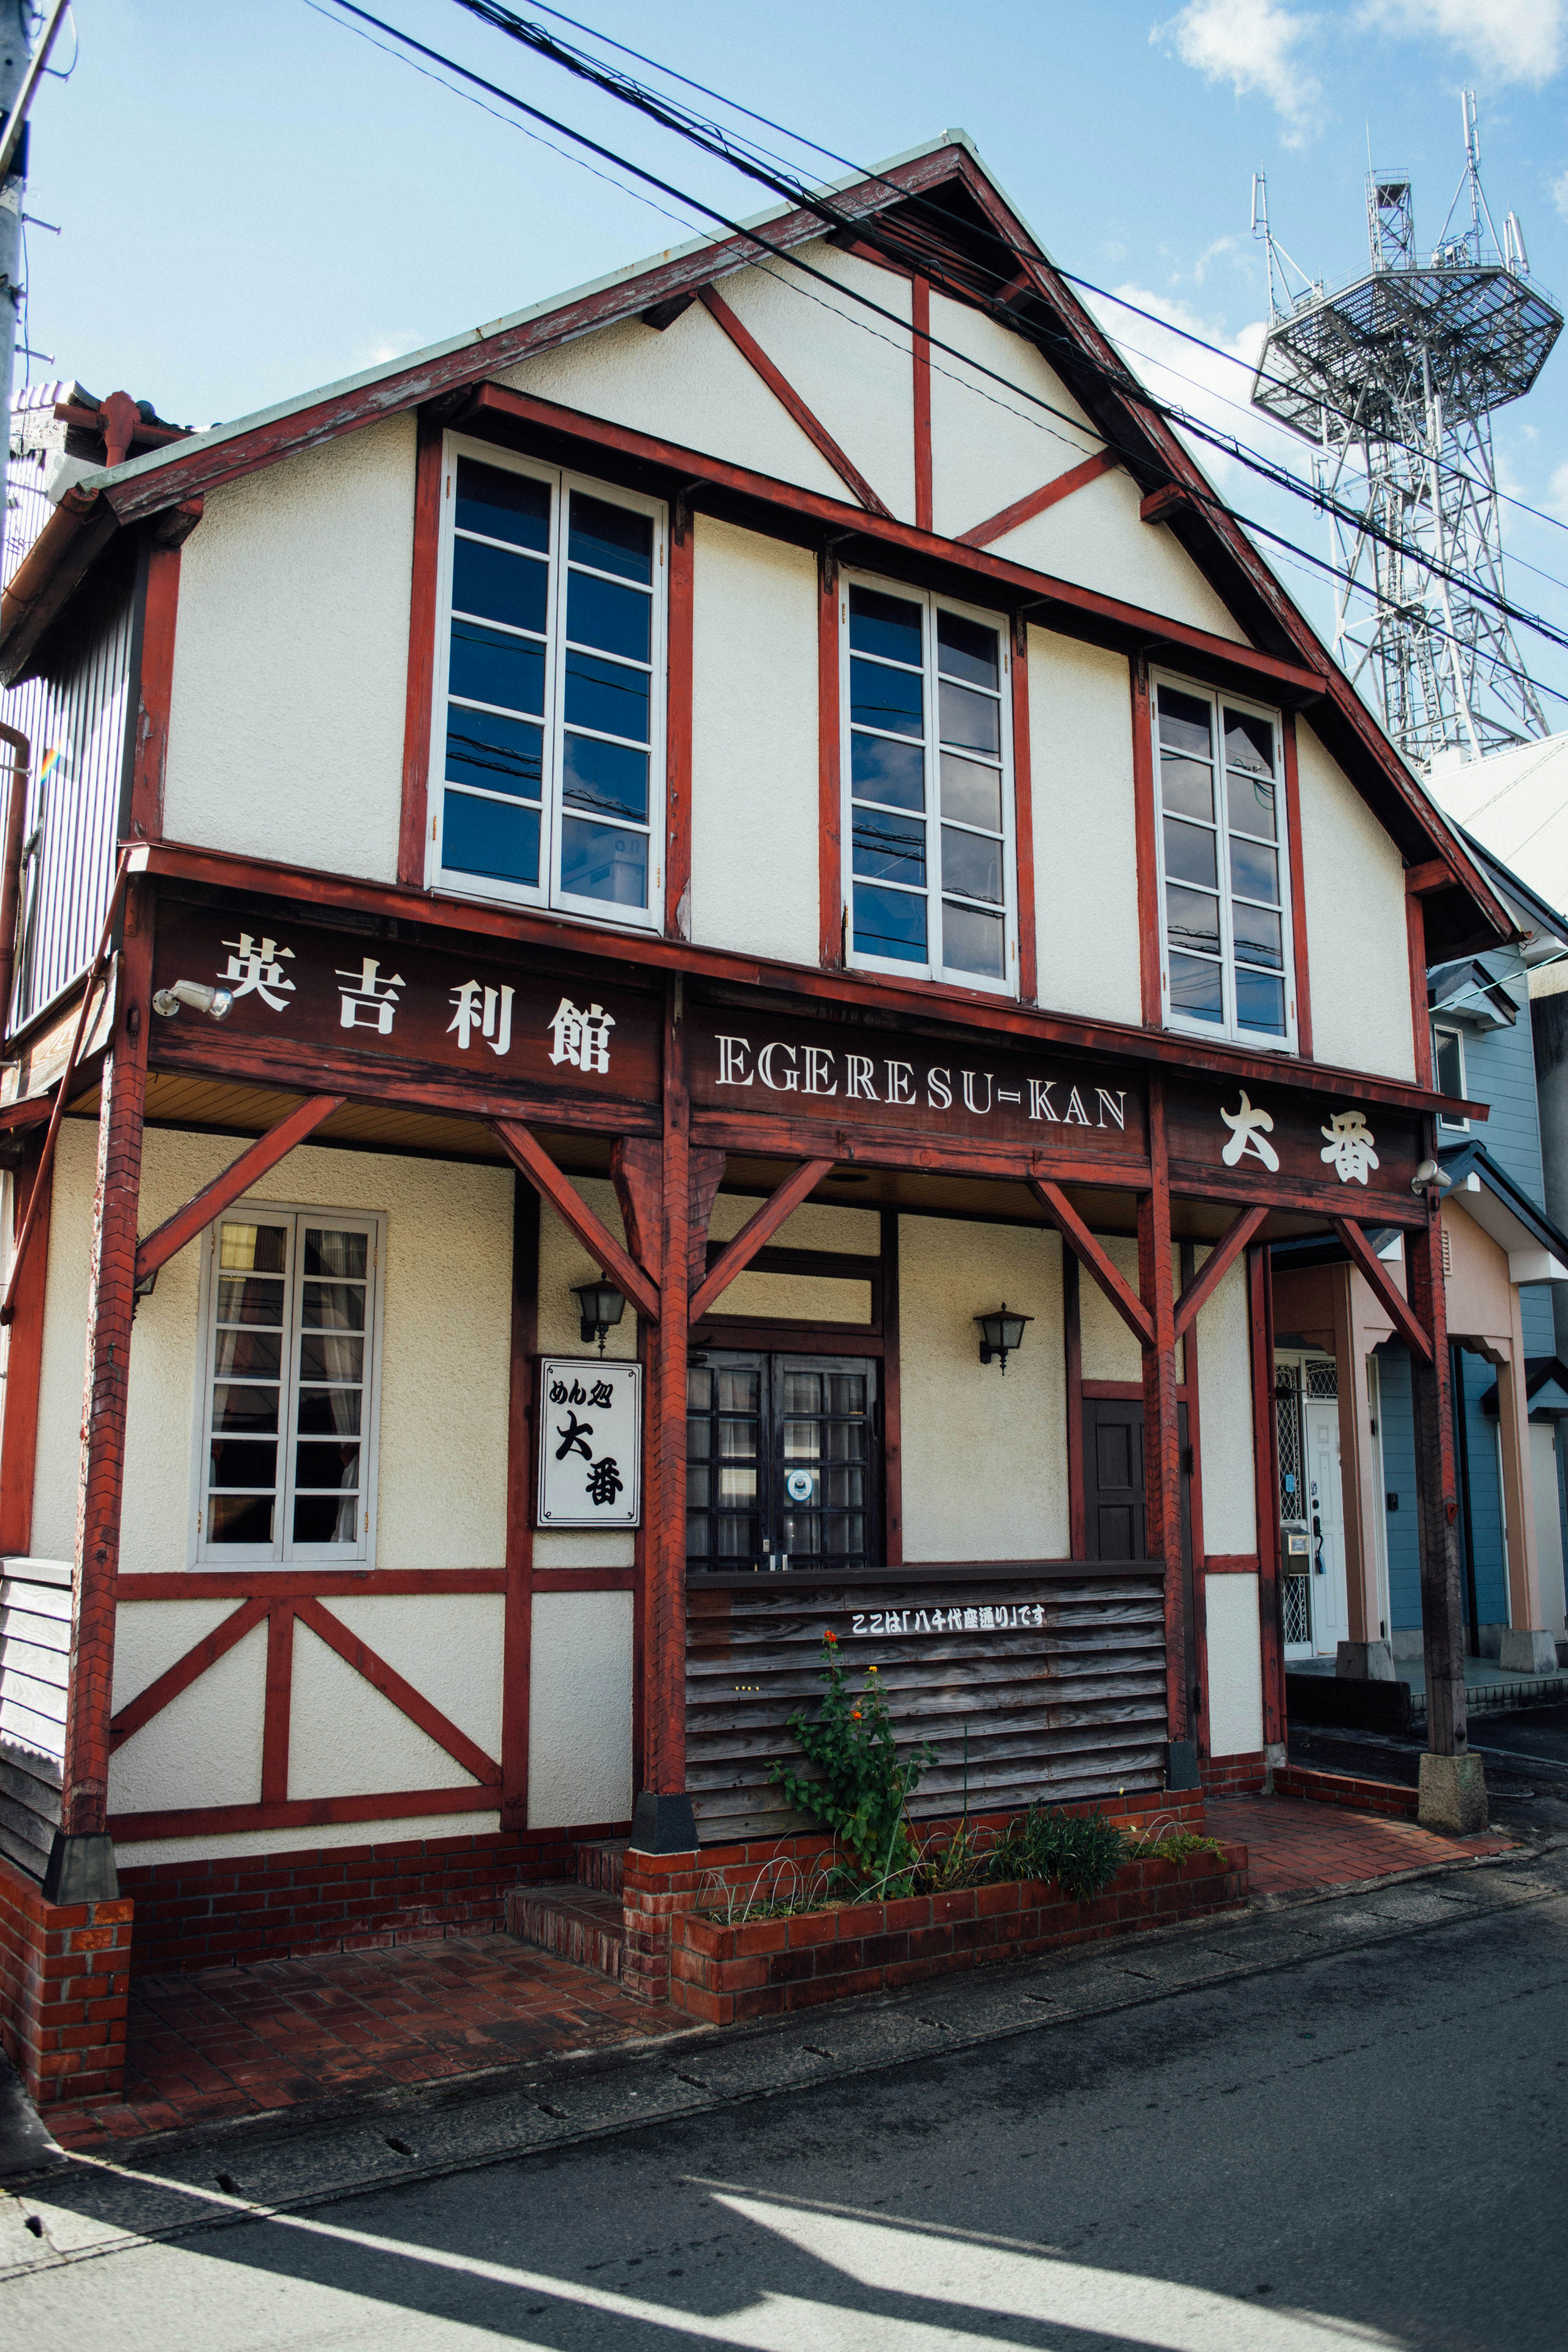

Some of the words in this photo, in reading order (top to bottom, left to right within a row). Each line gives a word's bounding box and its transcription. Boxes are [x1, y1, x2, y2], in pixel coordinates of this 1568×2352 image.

[216, 933, 615, 1074] 英吉利館
[1220, 1090, 1379, 1185] 大番
[549, 1378, 613, 1409] めん処
[555, 1410, 624, 1506] 大番
[852, 1604, 1045, 1634] ここは「八千代座通り」です
